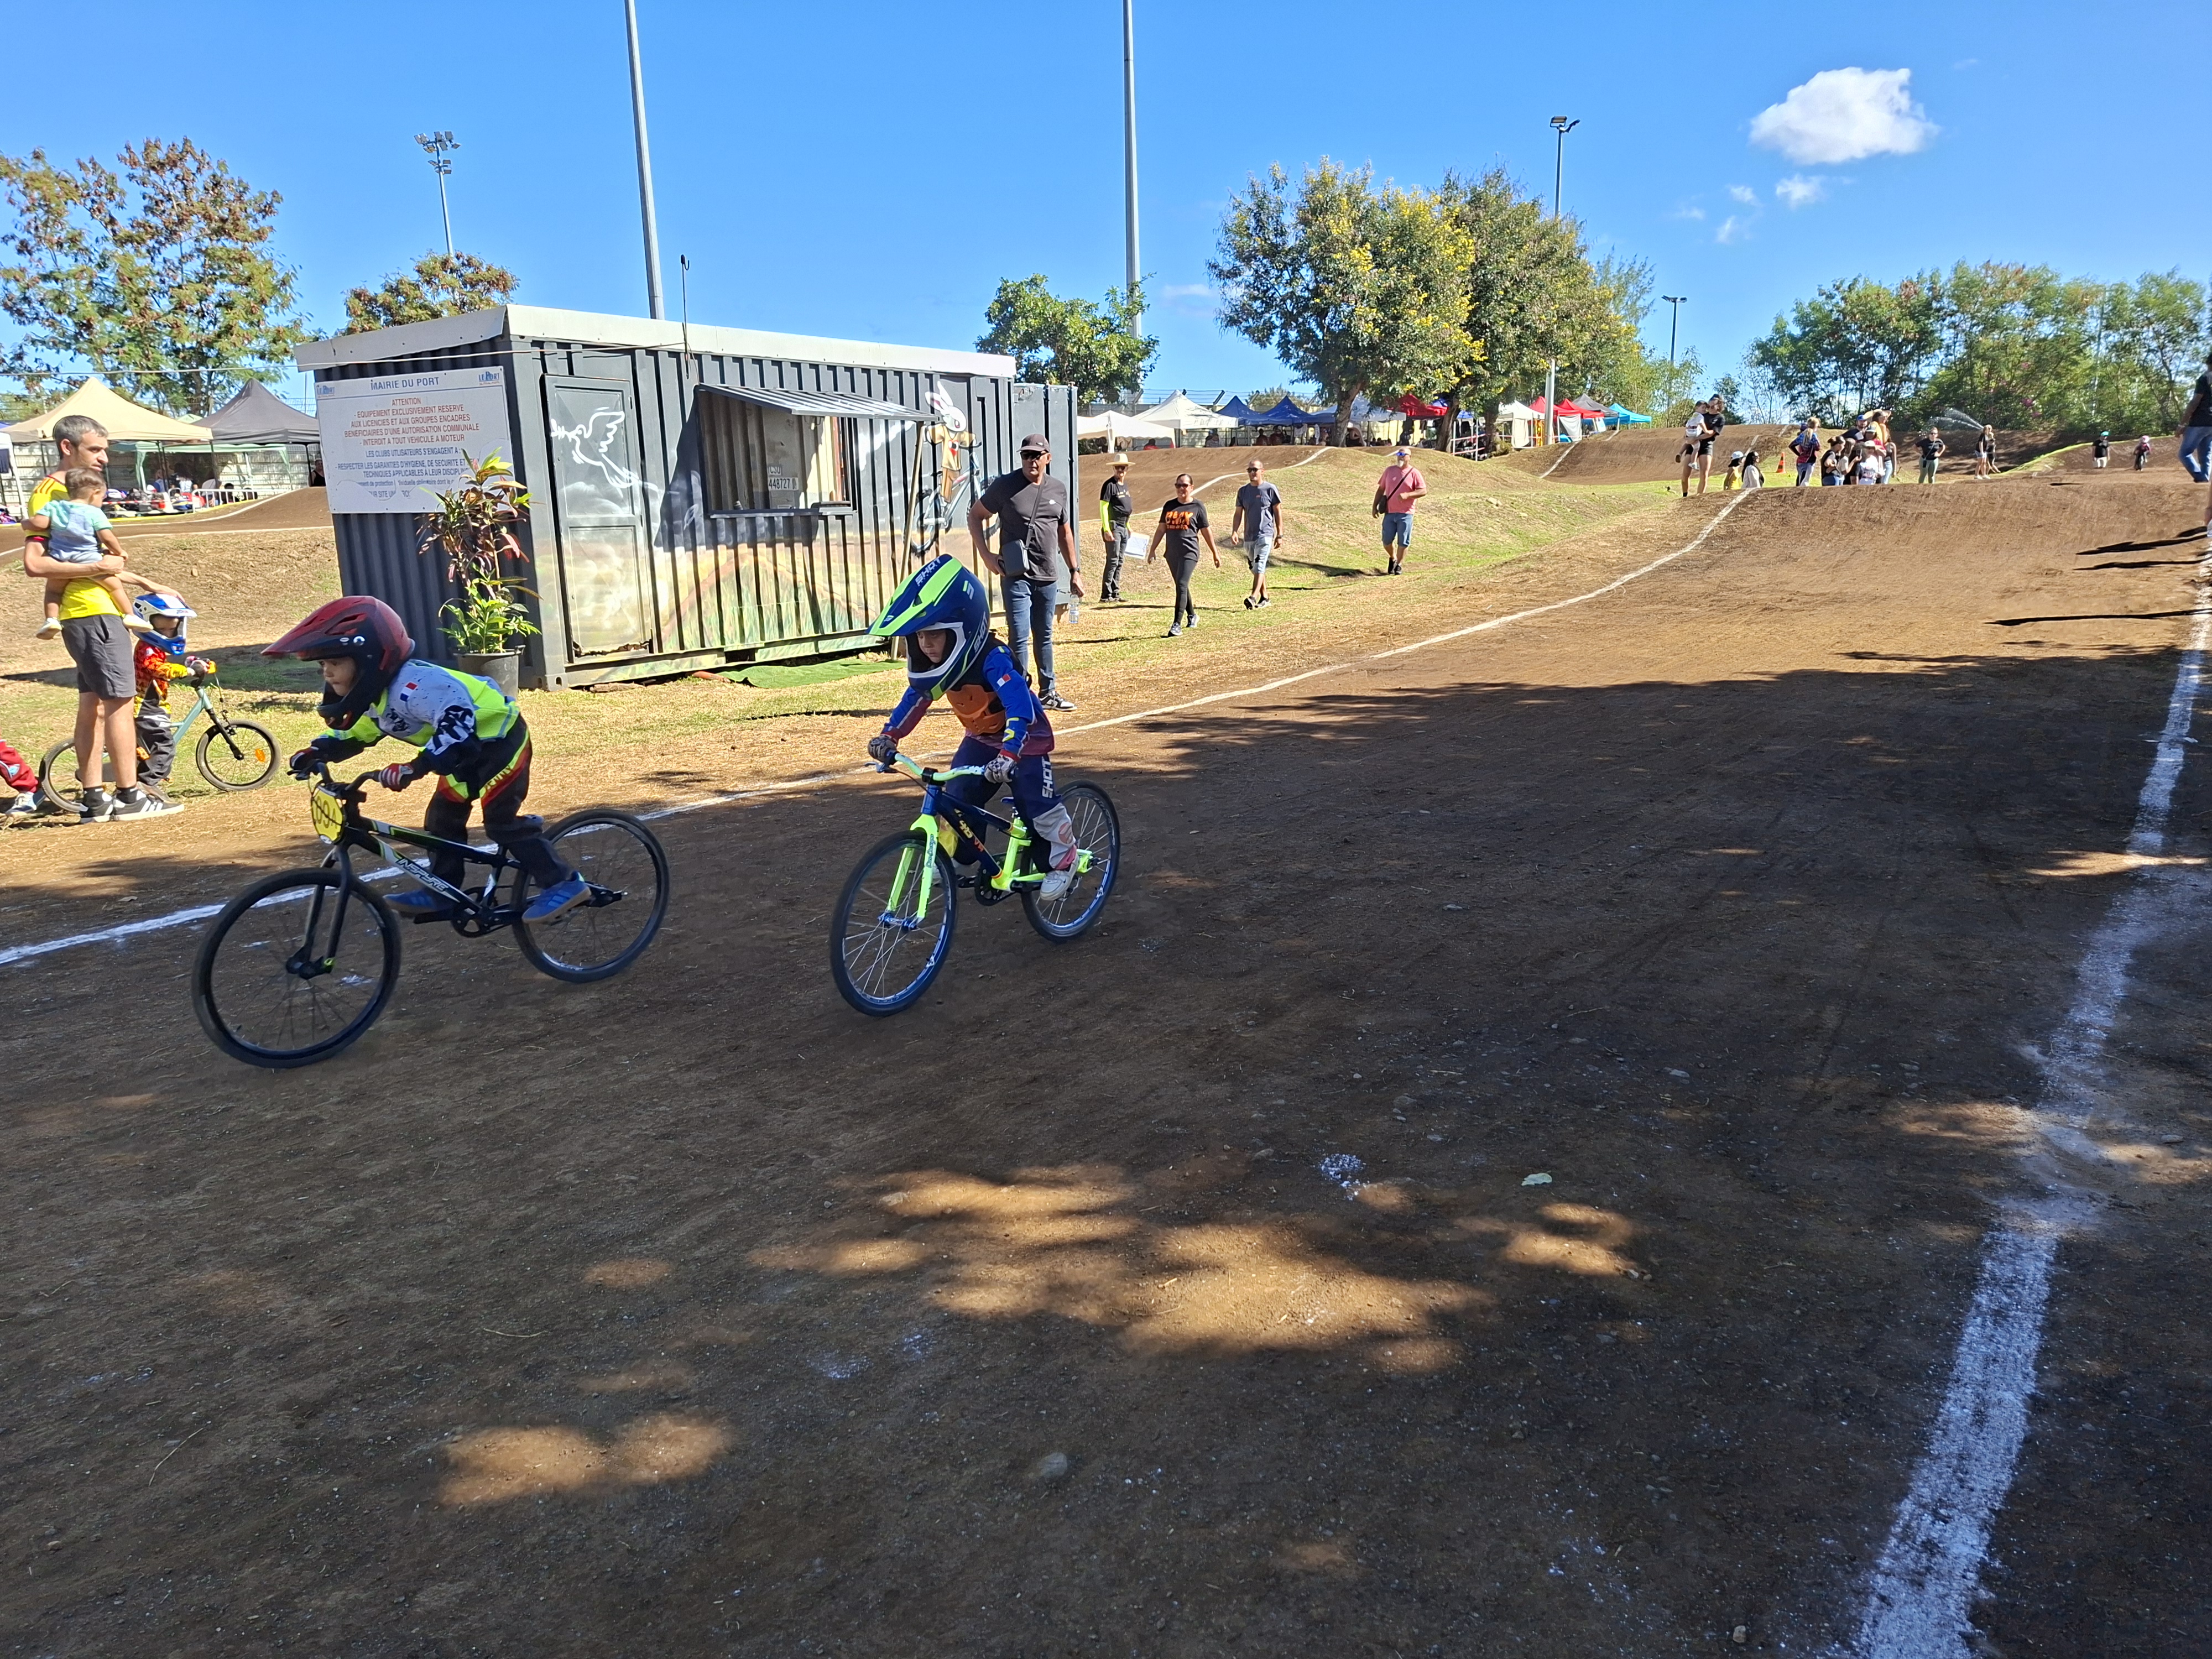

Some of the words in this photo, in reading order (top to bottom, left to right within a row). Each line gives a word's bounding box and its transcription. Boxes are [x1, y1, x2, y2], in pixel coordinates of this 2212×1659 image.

[485, 371, 500, 381] PORT
[371, 380, 399, 390] MAIRIE
[402, 379, 414, 388] DU
[417, 377, 439, 387] PORT
[392, 397, 421, 406] ATTENTION
[357, 409, 390, 418] EQUIPEMENT
[392, 406, 436, 415] EXCLUSIVEMENT
[438, 404, 464, 413] RESERVE
[363, 419, 390, 427] LICENCIES
[411, 415, 438, 424] GROUPES
[440, 414, 470, 422] ENCADRES
[345, 429, 384, 437] BENEFICIAIRES
[384, 427, 400, 436] D'UNE
[401, 425, 442, 434] AUTORISATION
[443, 423, 479, 432] COMMUNALE
[362, 437, 386, 446] INTERDIT
[407, 435, 434, 444] VEHICULE
[423, 447, 453, 455] S'ENGAGENT
[393, 469, 424, 477] APPLICABLES
[769, 478, 790, 489] 448727
[915, 556, 941, 585] SHOT
[974, 611, 988, 654] SHOT
[1041, 755, 1053, 799] SHOT
[397, 858, 450, 892] INSPYRE
